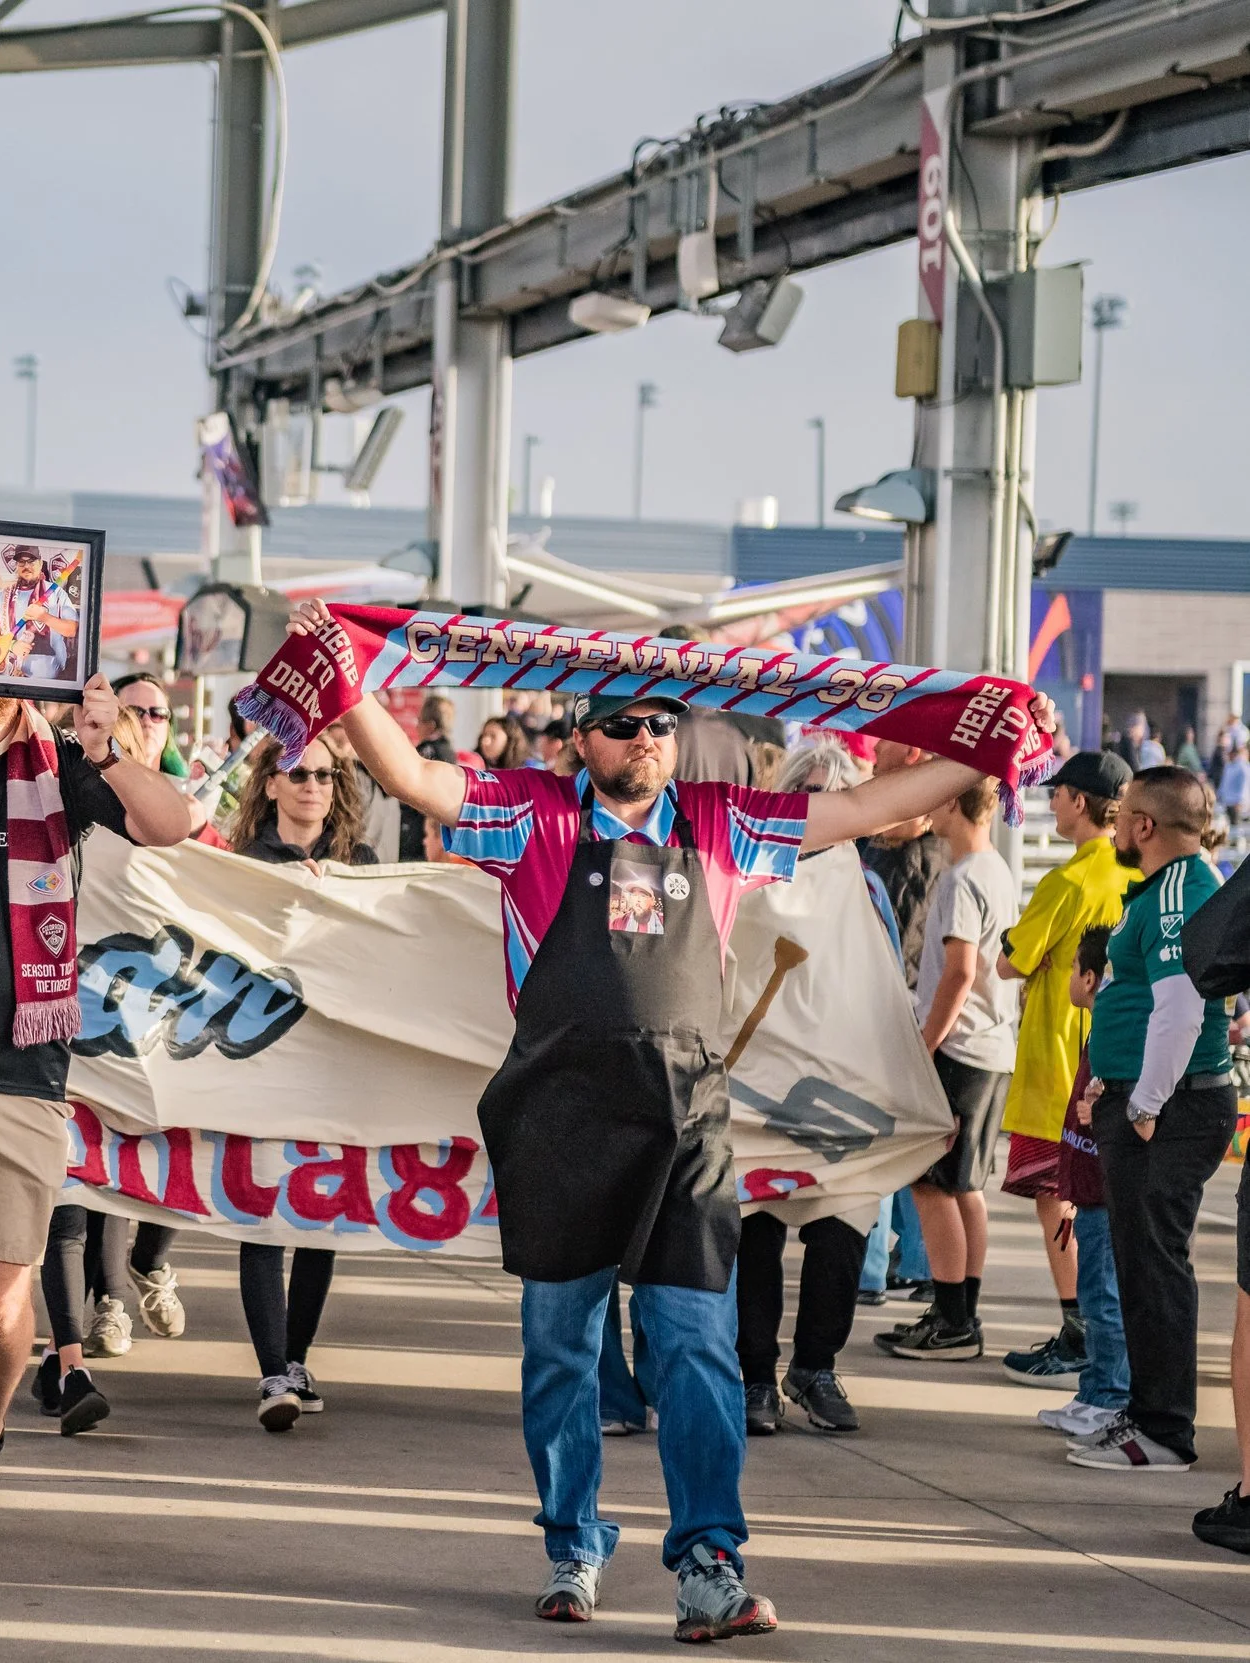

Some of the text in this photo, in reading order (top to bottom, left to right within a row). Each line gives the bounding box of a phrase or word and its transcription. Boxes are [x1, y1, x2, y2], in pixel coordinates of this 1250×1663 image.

[306, 648, 336, 690] TO
[314, 617, 360, 688] HERE
[405, 620, 908, 713] CENTENNIAL 38
[950, 682, 1013, 749] HERE
[990, 705, 1028, 742] TO
[21, 963, 56, 977] SEASON
